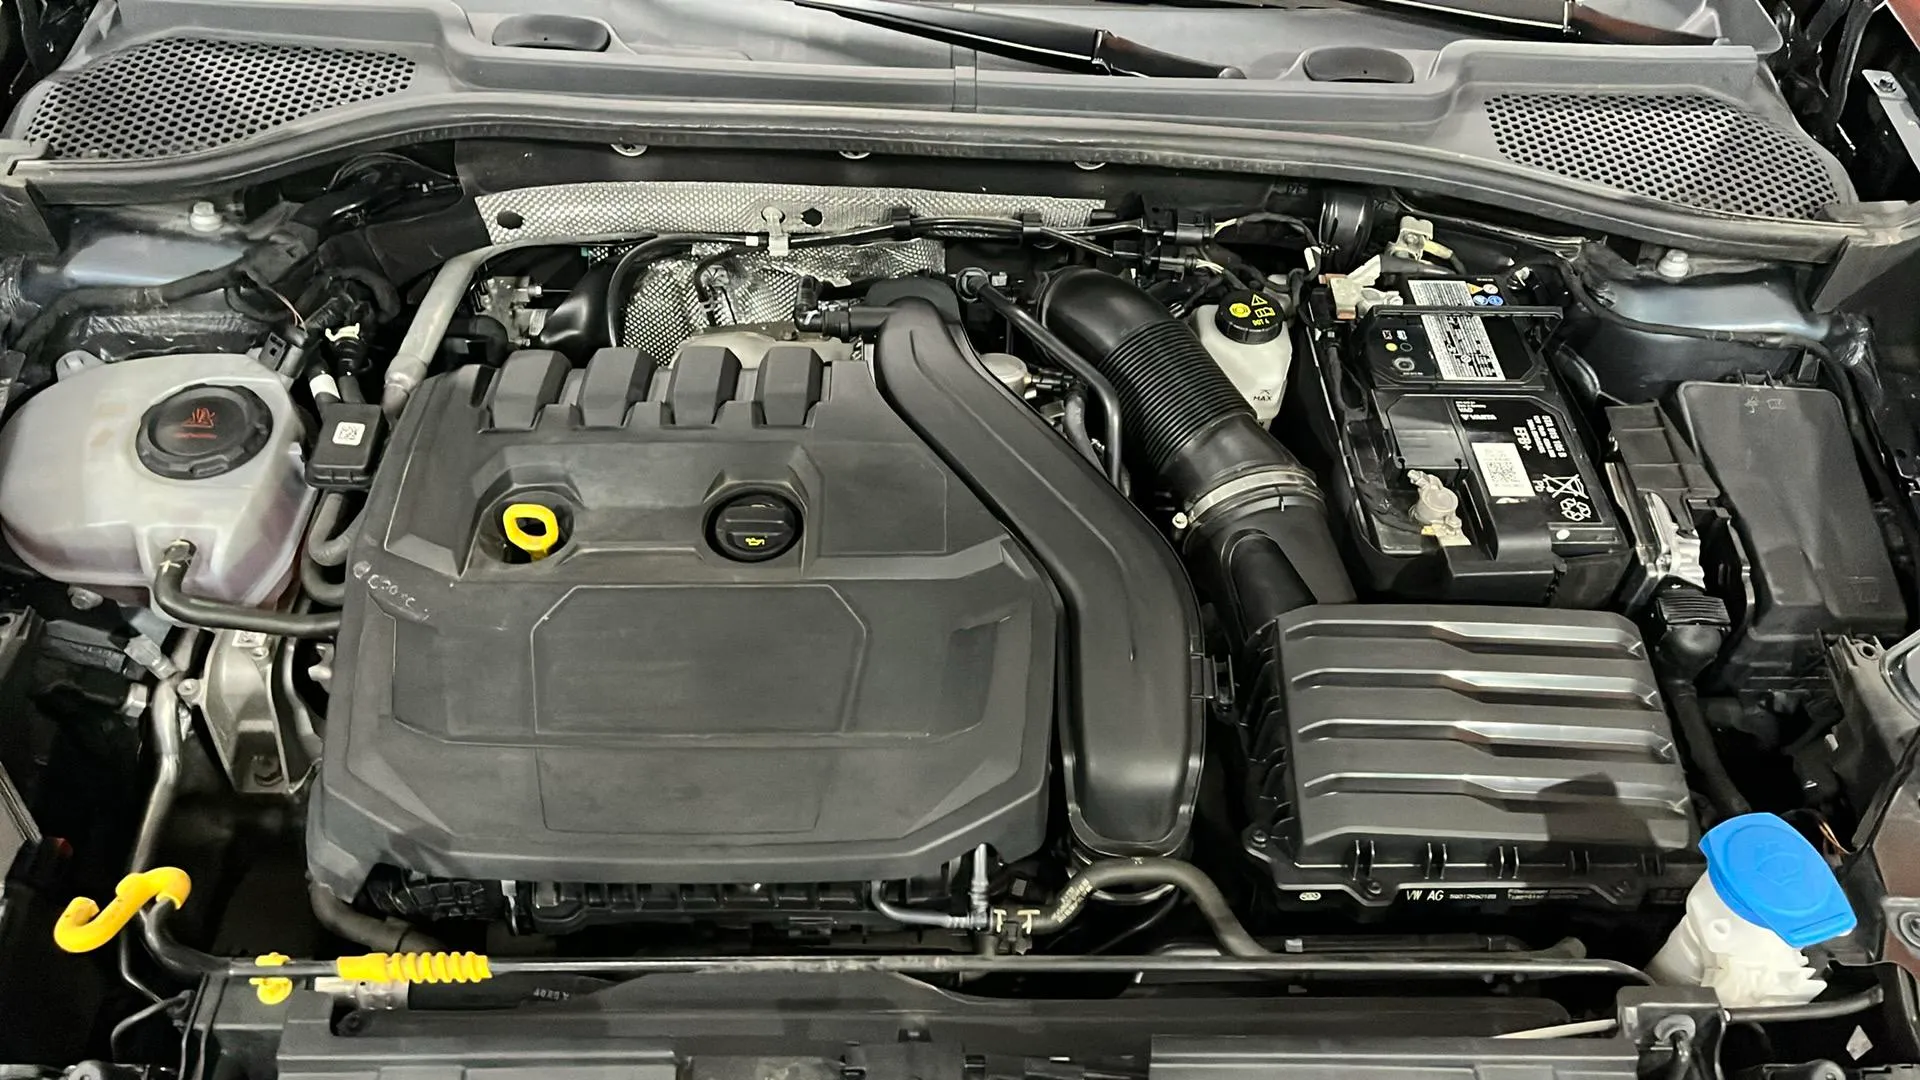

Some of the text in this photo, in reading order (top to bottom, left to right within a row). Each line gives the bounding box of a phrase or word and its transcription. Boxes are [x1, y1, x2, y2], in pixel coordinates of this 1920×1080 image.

[1513, 426, 1532, 451] EFB+
[1406, 890, 1423, 900] VW
[1427, 890, 1444, 901] AG
